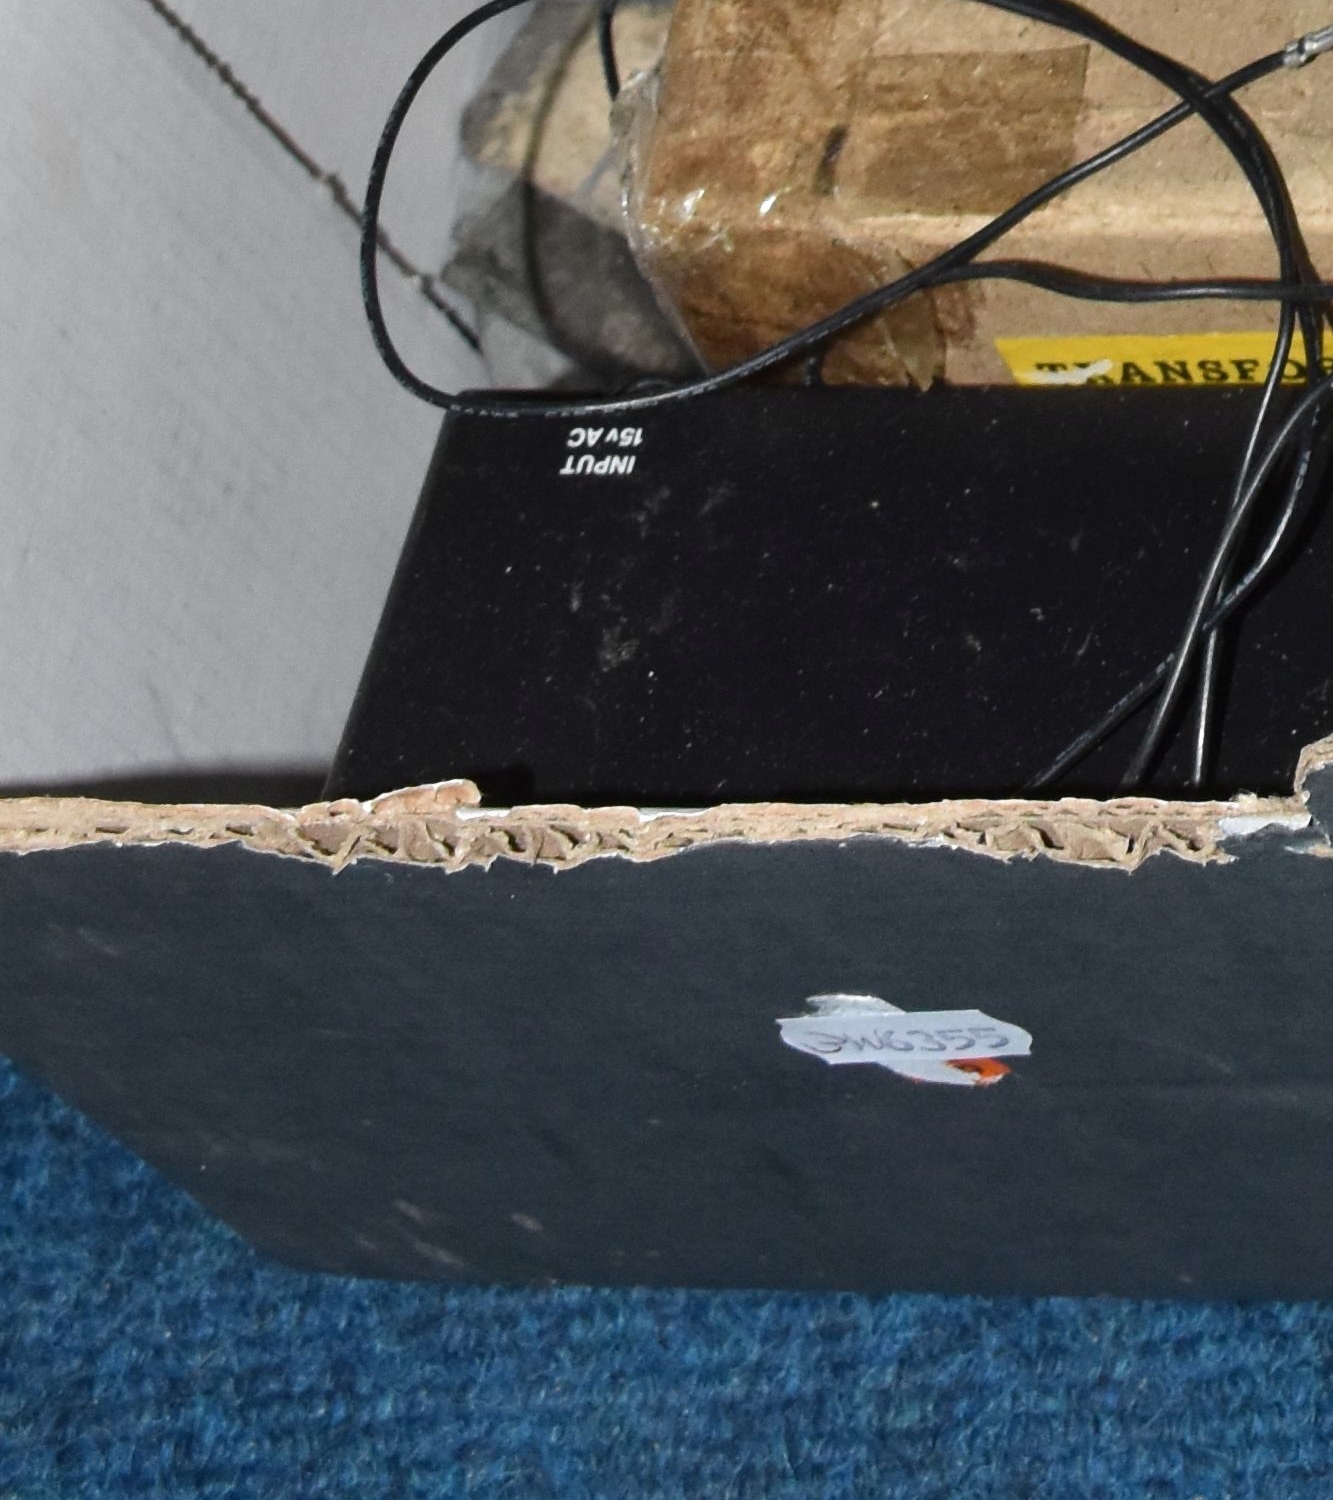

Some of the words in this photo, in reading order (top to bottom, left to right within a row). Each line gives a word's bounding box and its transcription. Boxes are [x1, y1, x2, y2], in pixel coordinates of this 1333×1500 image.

[565, 426, 605, 448] AC
[603, 427, 644, 447] 15v
[559, 454, 637, 476] INPUT
